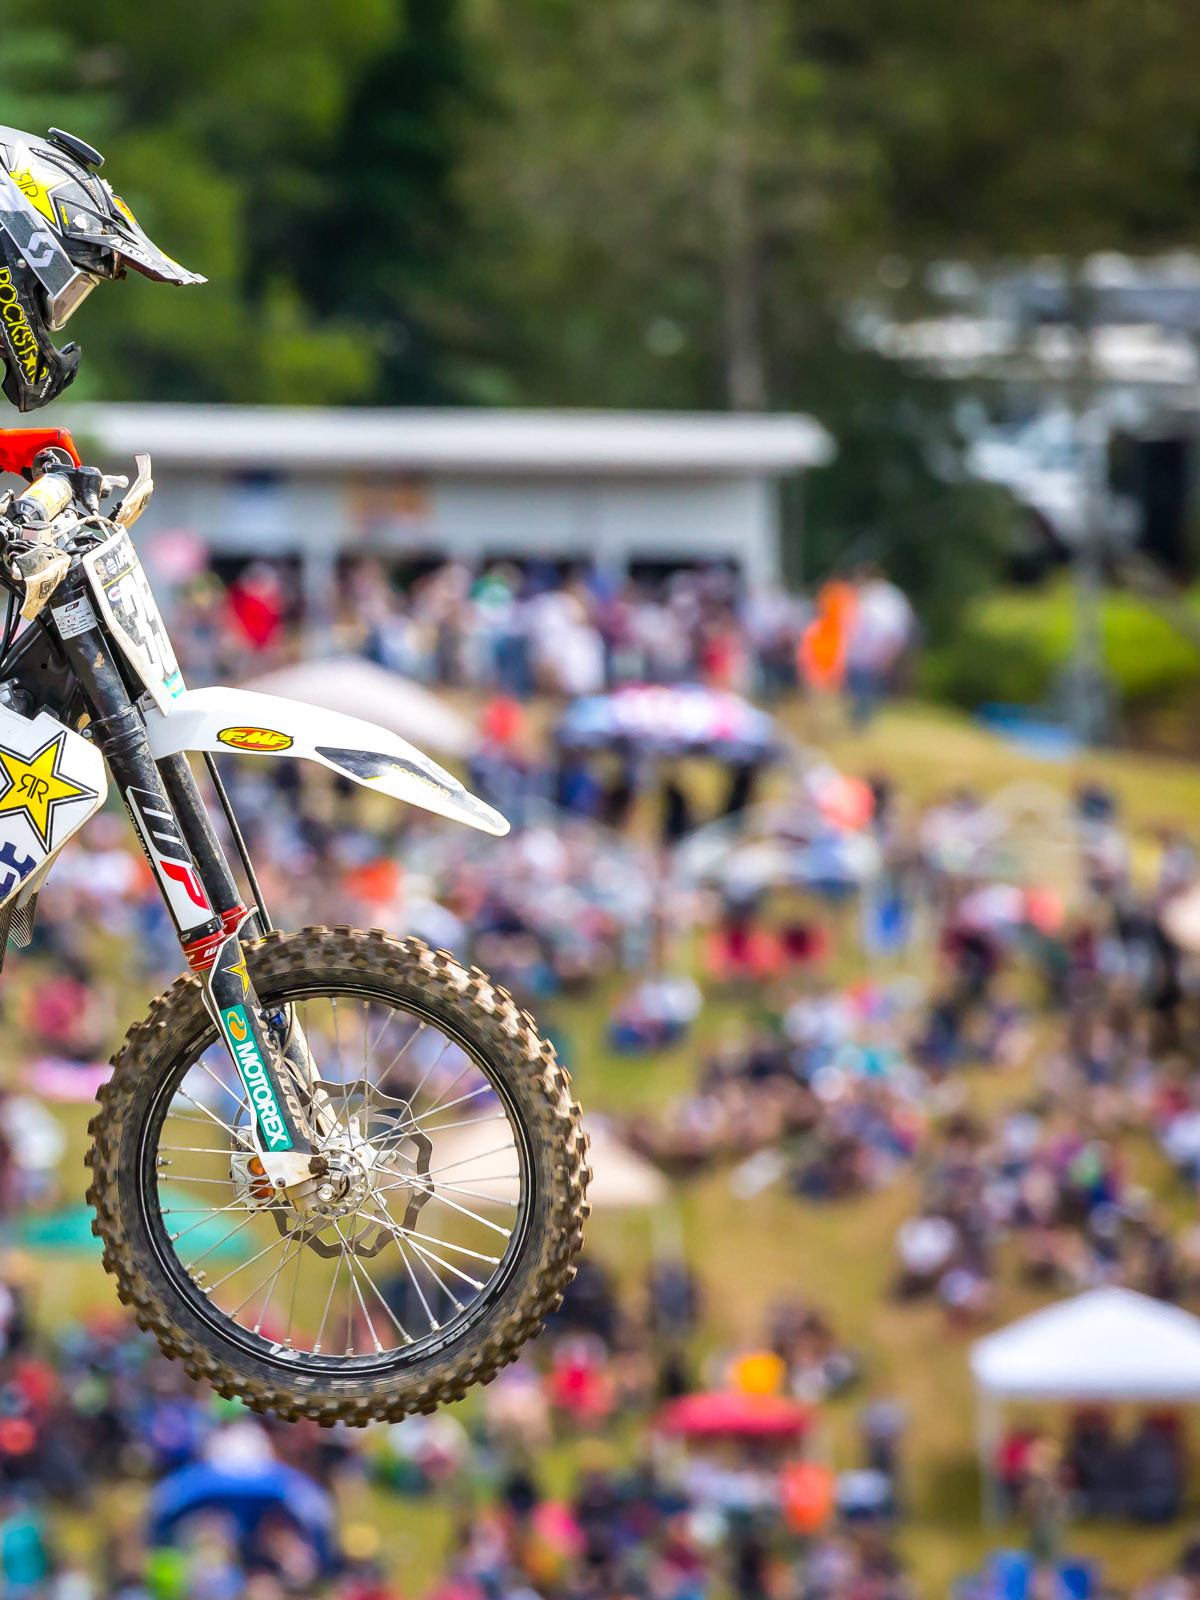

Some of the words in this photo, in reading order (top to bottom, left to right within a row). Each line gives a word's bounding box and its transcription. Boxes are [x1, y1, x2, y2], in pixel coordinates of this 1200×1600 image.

[108, 238, 153, 264] Airoh
[218, 729, 293, 748] FMF
[236, 1041, 288, 1147] MOTOREX
